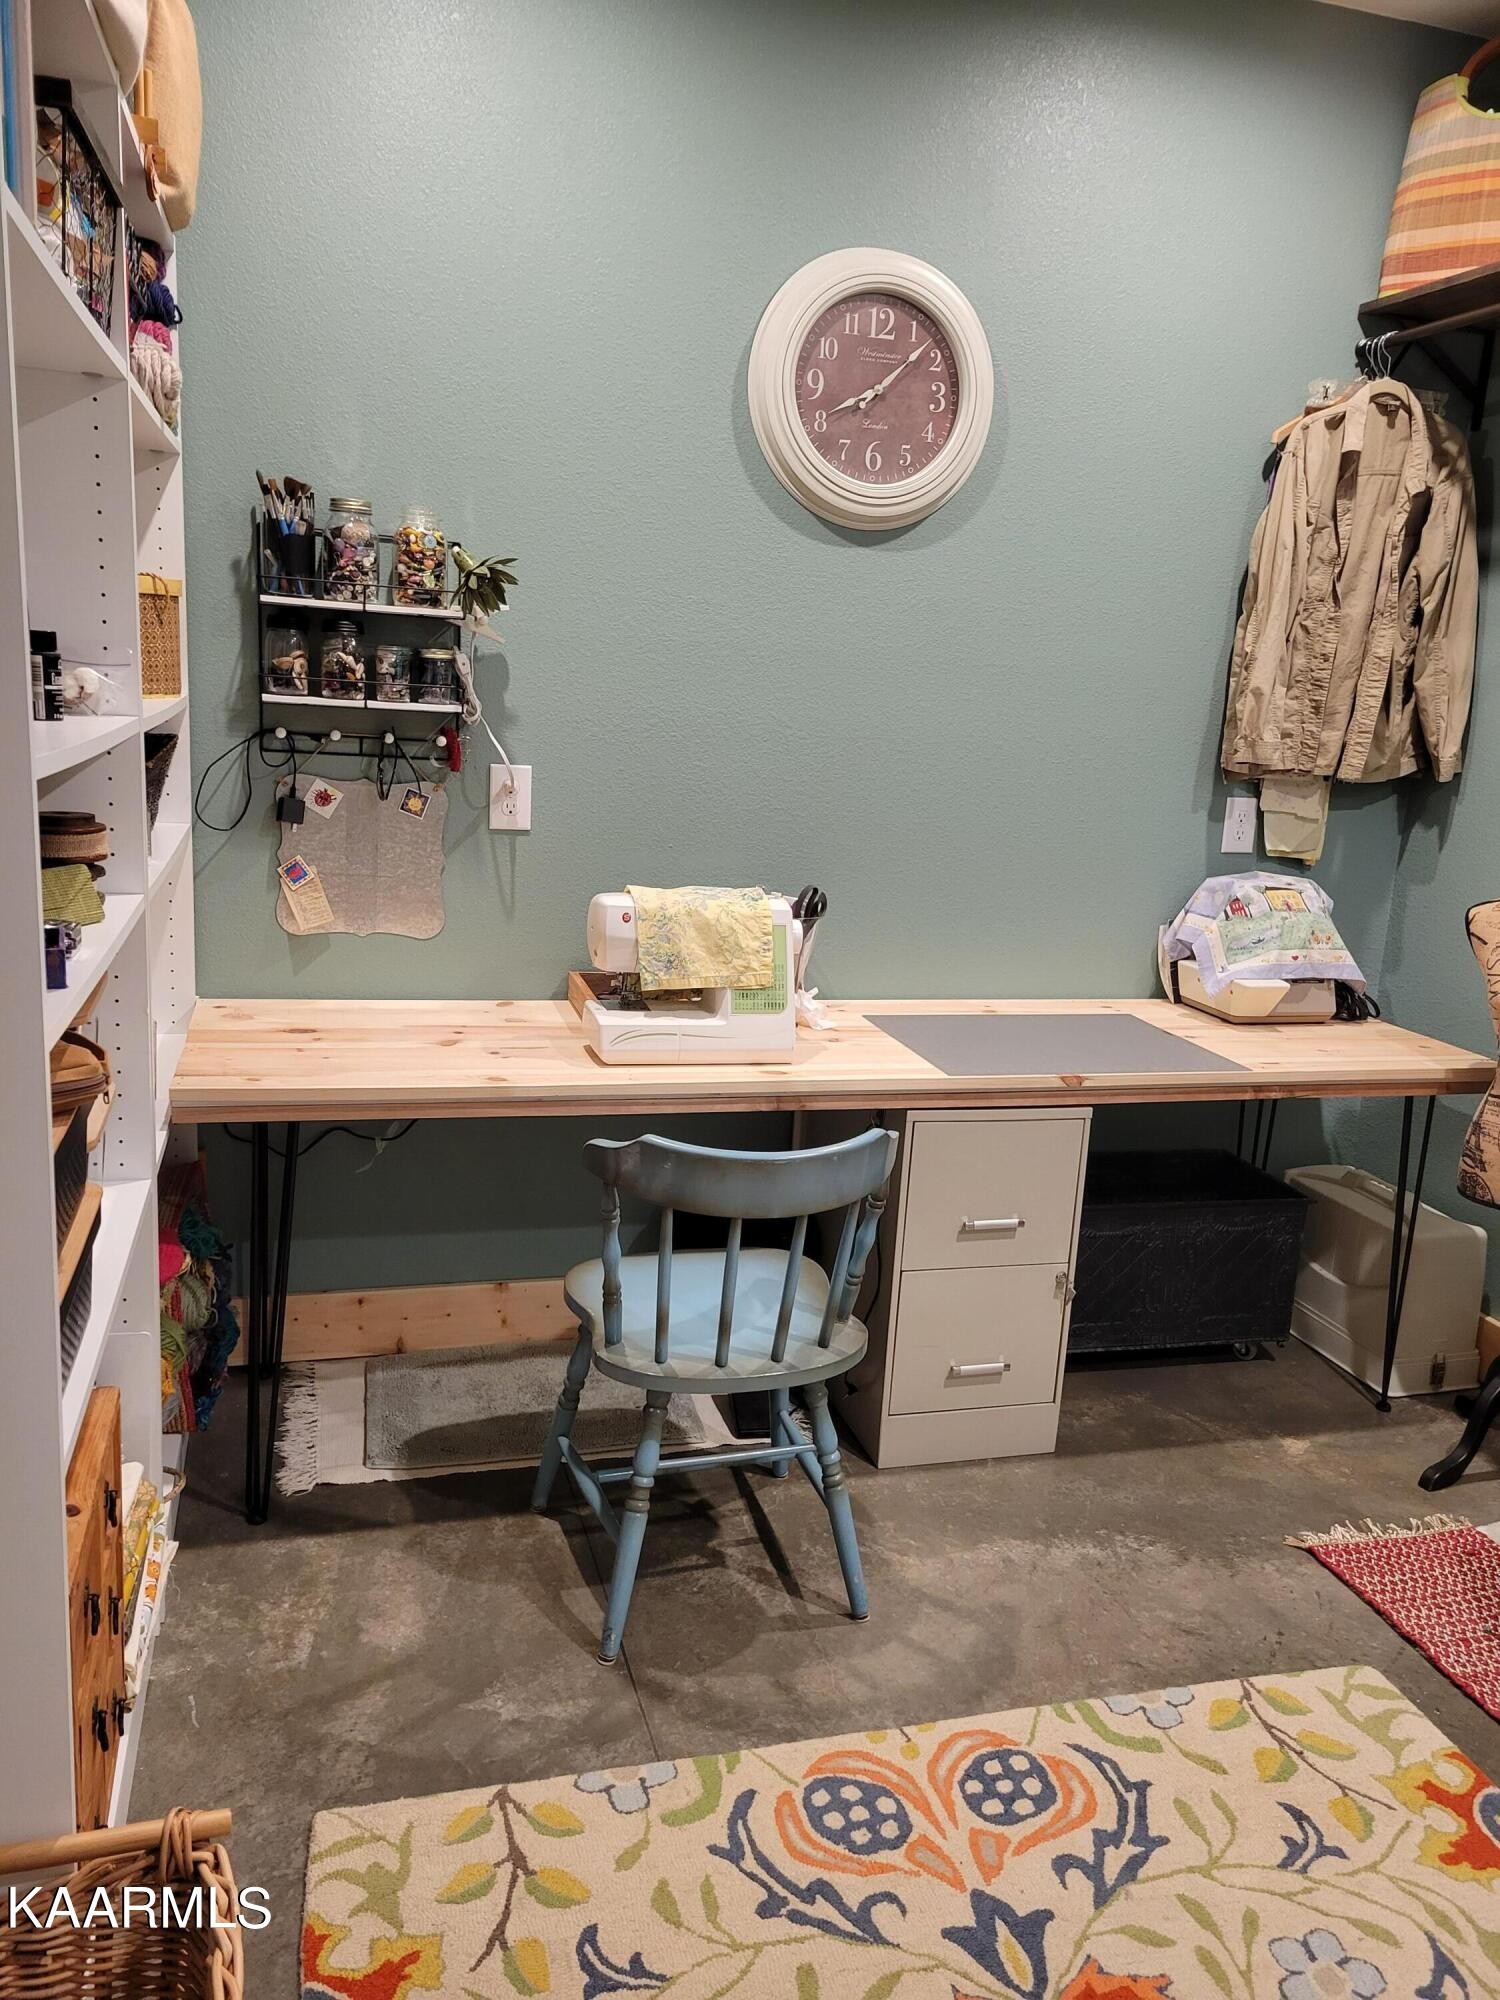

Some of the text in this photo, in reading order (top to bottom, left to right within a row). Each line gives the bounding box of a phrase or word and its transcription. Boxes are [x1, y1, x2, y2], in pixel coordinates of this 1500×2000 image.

[843, 312, 860, 335] 11
[867, 306, 896, 341] 12
[908, 320, 918, 342] 1
[817, 336, 838, 360] 10
[928, 349, 942, 371] 2
[807, 368, 825, 400] 9
[929, 381, 946, 413] 3
[813, 410, 827, 433] 8
[861, 418, 889, 431] London
[921, 422, 935, 443] 4
[838, 439, 851, 460] 7
[864, 441, 882, 472] 6
[899, 444, 911, 466] 5
